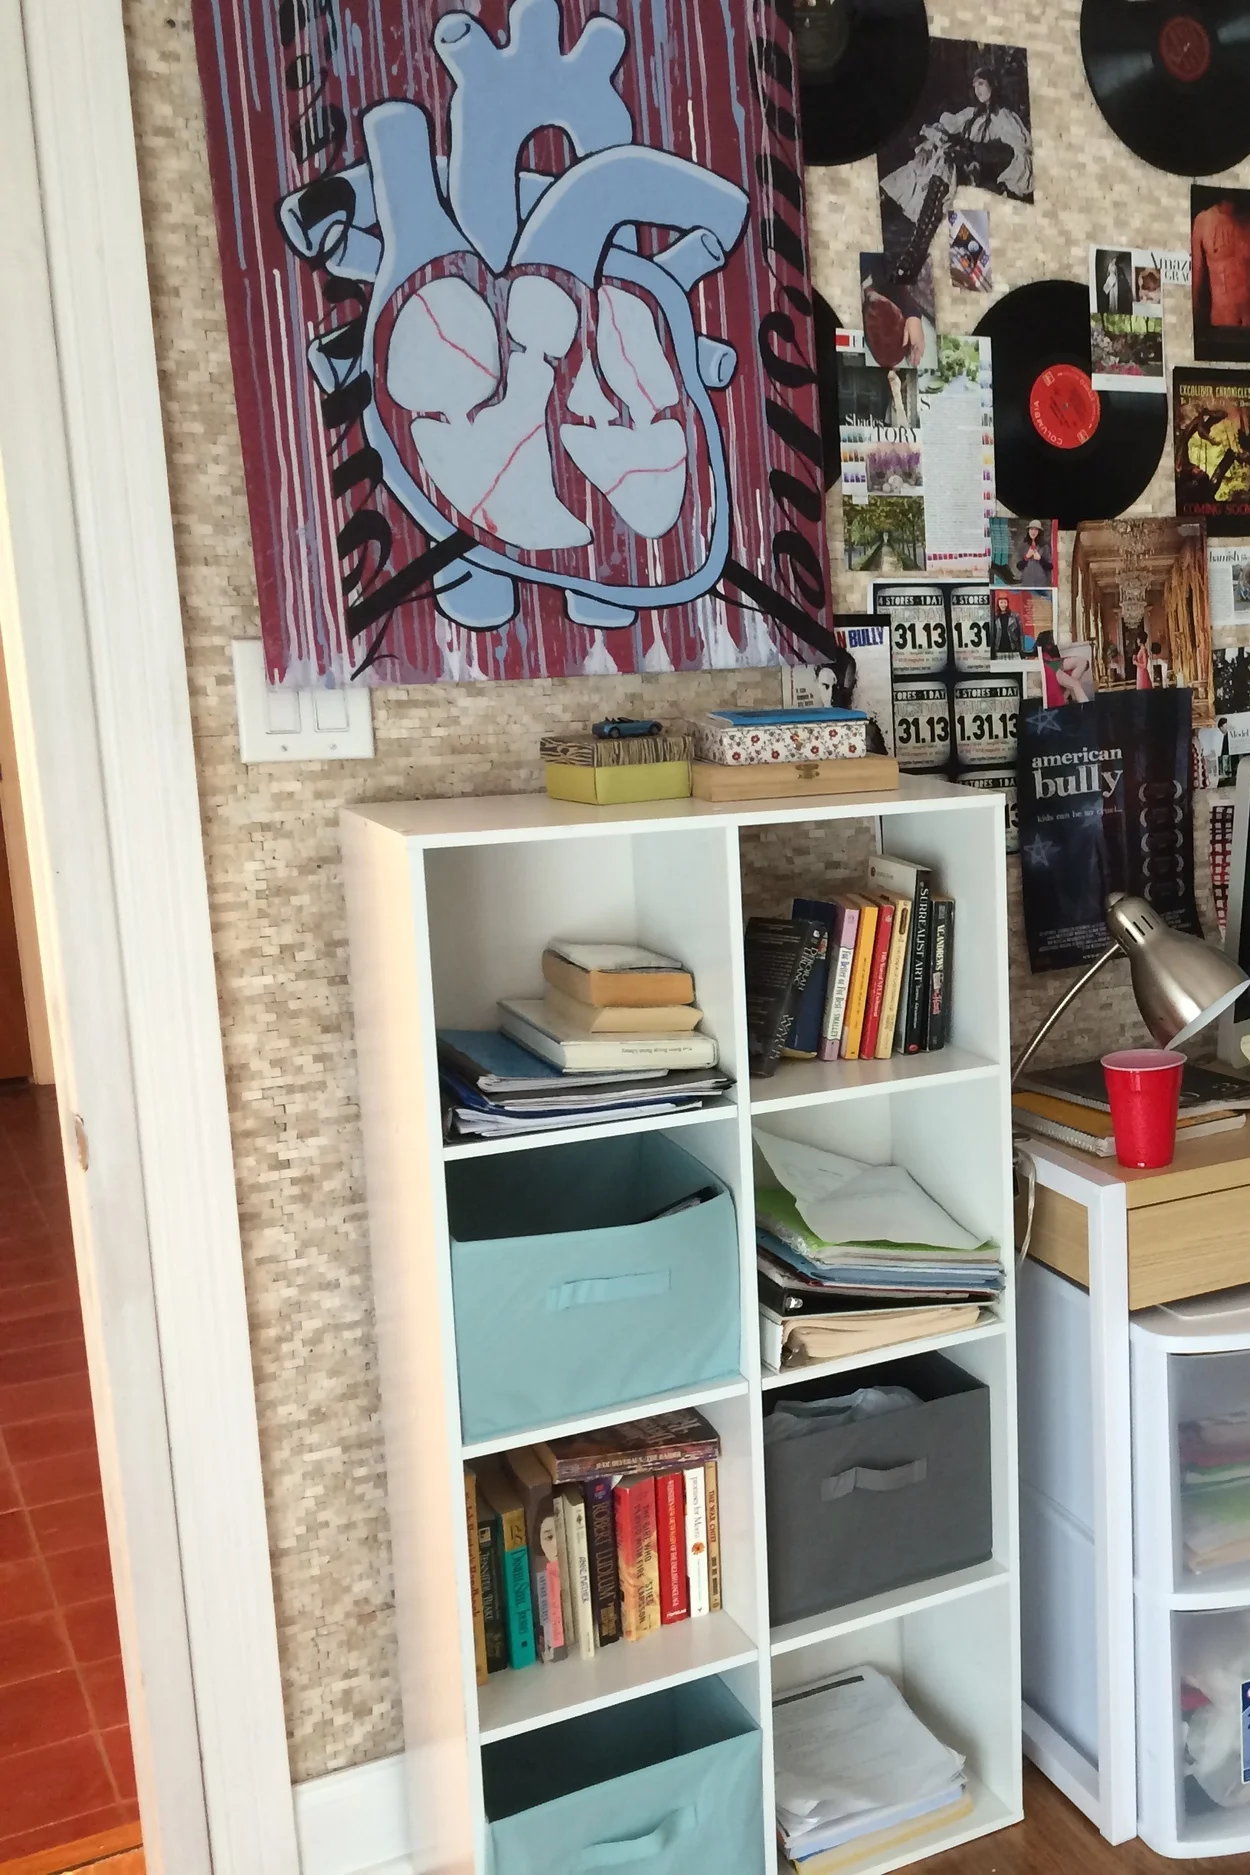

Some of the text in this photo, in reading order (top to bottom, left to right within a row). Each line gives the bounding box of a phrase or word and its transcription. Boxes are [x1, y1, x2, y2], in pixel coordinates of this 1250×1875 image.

[1033, 400, 1063, 446] COLUMBIA
[886, 595, 914, 606] STORES
[926, 595, 943, 606] DAY
[960, 595, 988, 605] STORES
[848, 626, 884, 648] BULLY
[929, 690, 945, 700] DAY
[962, 688, 991, 698] STORES
[1002, 687, 1018, 697] DAY
[957, 713, 1019, 741] 1.31.13
[1032, 746, 1123, 768] american
[1032, 764, 1123, 800] bully
[1037, 812, 1053, 822] kids
[1072, 809, 1082, 818] be
[914, 888, 929, 983] SURREALIST ART
[841, 950, 851, 960] For
[839, 961, 850, 978] Better
[836, 986, 846, 996] For
[834, 996, 844, 1009] Best
[592, 1502, 613, 1546] ROBERT
[642, 1520, 650, 1540] GIRL
[644, 1543, 652, 1562] WHO
[511, 1549, 527, 1583] DANIELLE
[595, 1548, 617, 1600] LUDLUM
[480, 1551, 493, 1619] JENNIFER BLAKE
[637, 1585, 646, 1623] LARSSON
